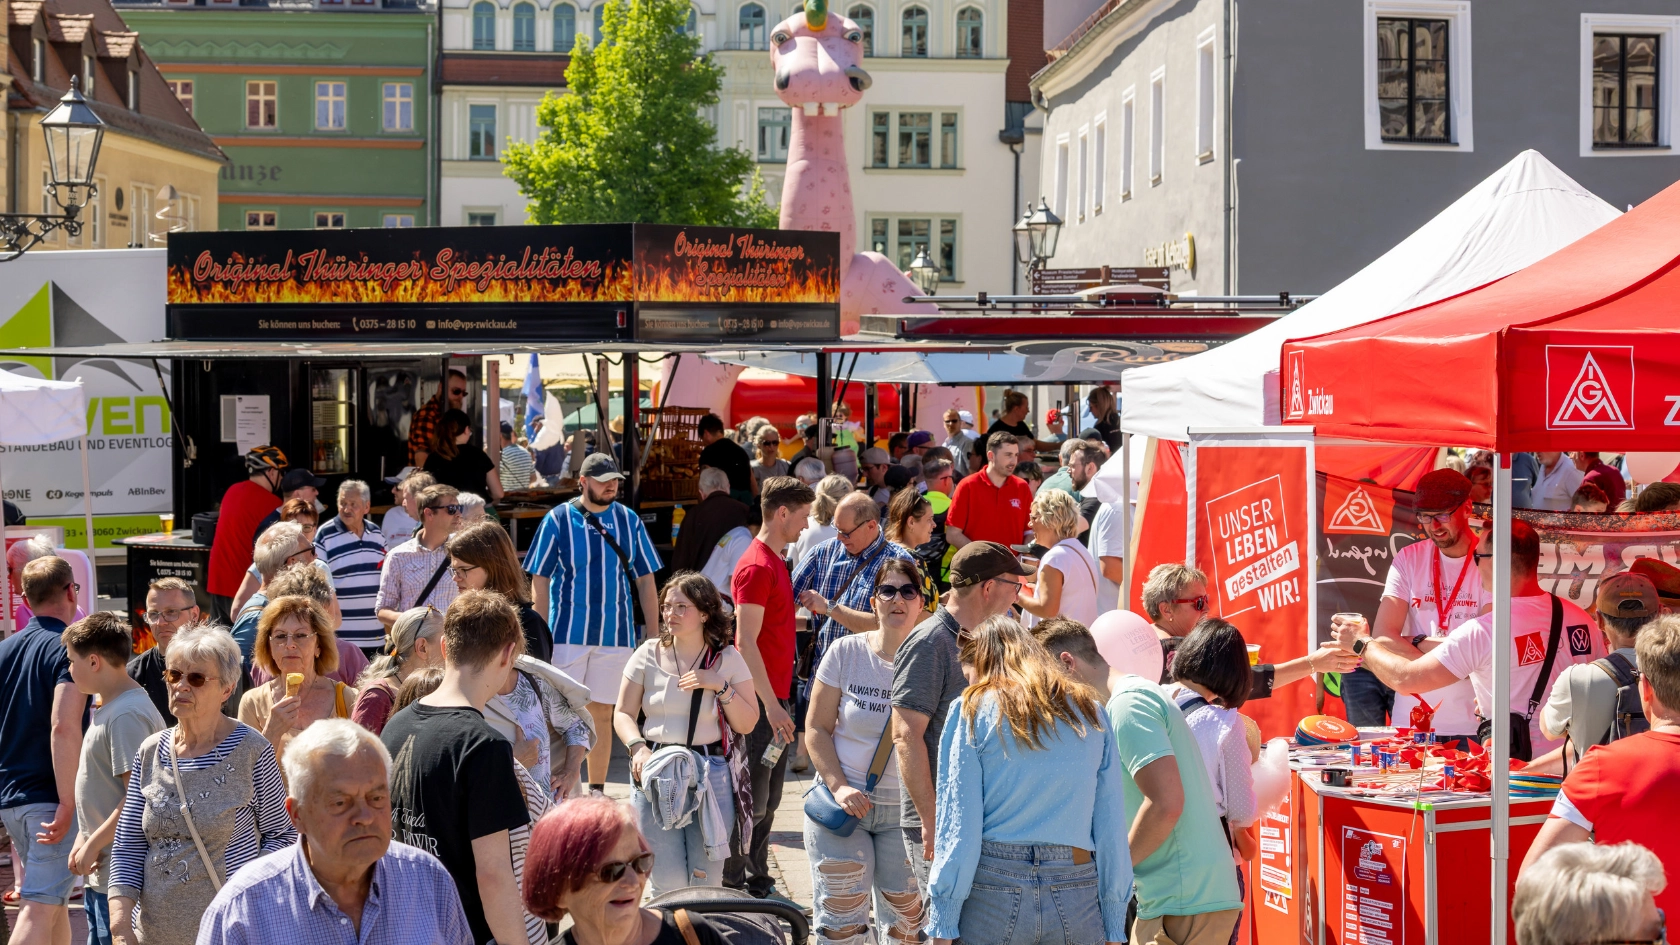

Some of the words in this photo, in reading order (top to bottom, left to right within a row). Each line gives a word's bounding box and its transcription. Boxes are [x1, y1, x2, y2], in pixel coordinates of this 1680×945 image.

[674, 231, 734, 262] Original
[736, 233, 805, 268] Thüringer
[193, 249, 292, 293] Original
[297, 249, 422, 292] Thüringer
[429, 246, 602, 292] Spezialitäten
[695, 261, 787, 296] Spezialitäten
[258, 319, 270, 329] Sie
[270, 319, 297, 329] können
[298, 321, 311, 329] uns
[311, 319, 341, 329] buchen:
[360, 319, 379, 329] 0375
[386, 319, 397, 329] 28
[398, 319, 406, 329] 15
[407, 319, 416, 329] 10
[437, 319, 517, 331] info@vps-zwickau.de
[644, 319, 654, 329] Sie
[654, 319, 676, 329] können
[676, 320, 687, 329] uns
[687, 319, 710, 329] buchen:
[1307, 387, 1334, 415] Zwickau
[78, 439, 106, 451] ND
[64, 489, 114, 499] Kegempuls
[127, 487, 167, 497] ABInBev
[1218, 498, 1274, 539] UNSER
[86, 528, 114, 537] 8060
[117, 527, 153, 536] Zwickau
[1225, 524, 1278, 566] LEBEN
[1231, 547, 1293, 596] gestalten
[1257, 576, 1301, 613] WIR!
[1452, 600, 1478, 608] UKUNFT.
[847, 683, 880, 698] ALWAYS
[869, 701, 887, 713] WAY
